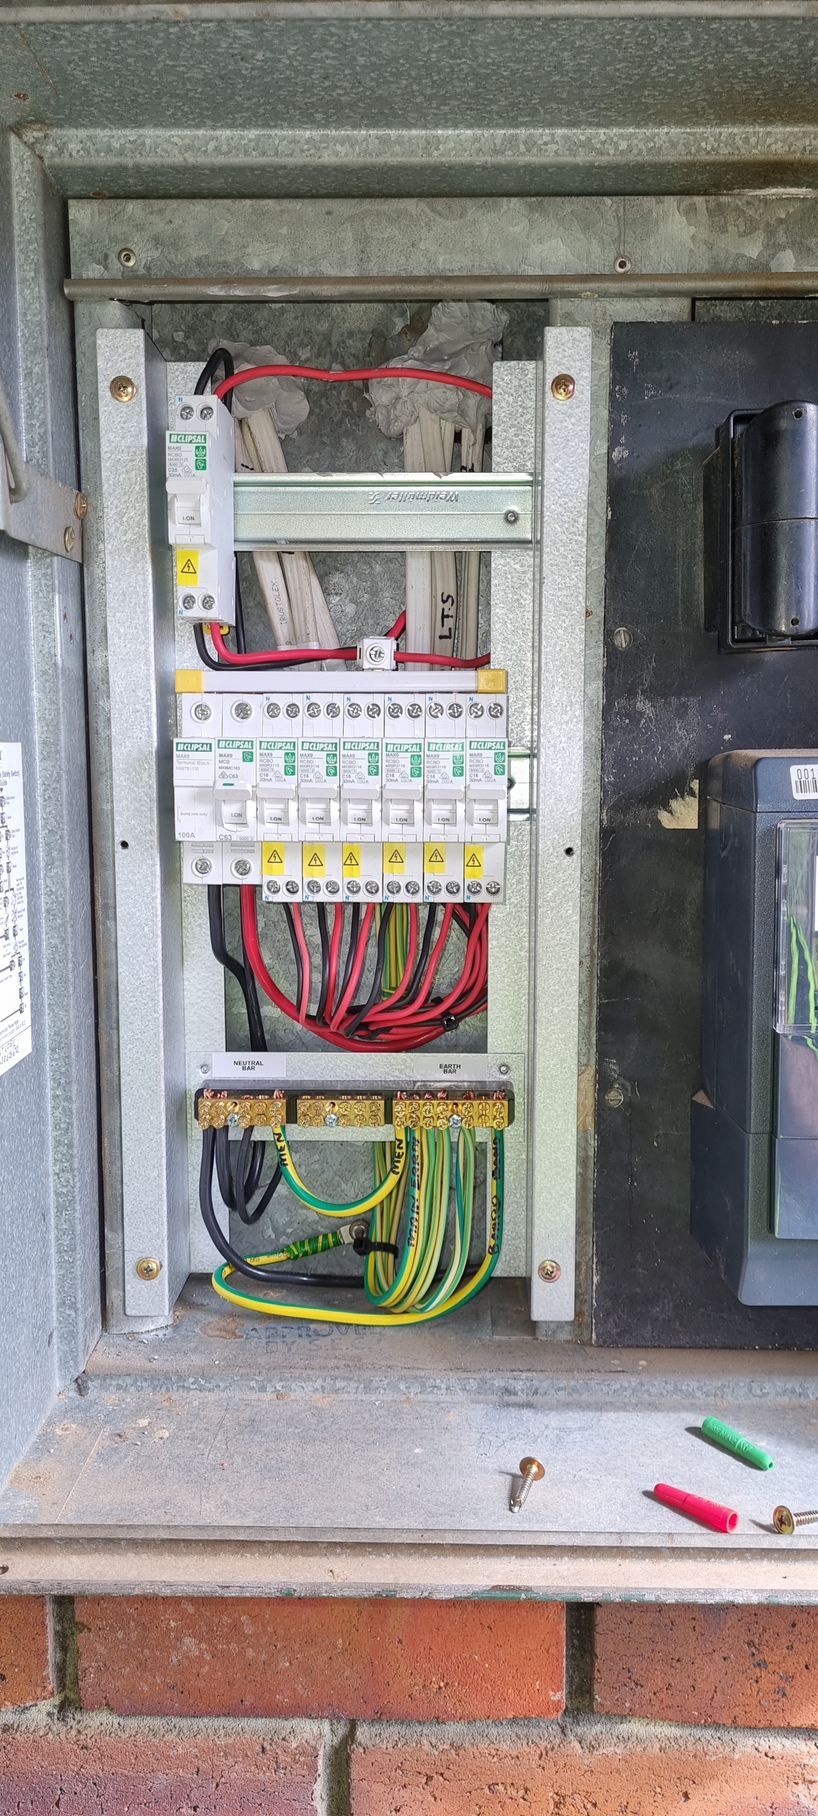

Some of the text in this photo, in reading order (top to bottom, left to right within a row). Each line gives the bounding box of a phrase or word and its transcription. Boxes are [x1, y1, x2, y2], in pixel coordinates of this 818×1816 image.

[177, 434, 206, 443] CLIPSAL
[226, 740, 252, 749] CLIPSAL
[268, 742, 294, 750] CLIPSAL
[273, 1132, 289, 1168] MEN
[392, 1138, 405, 1176] MEN
